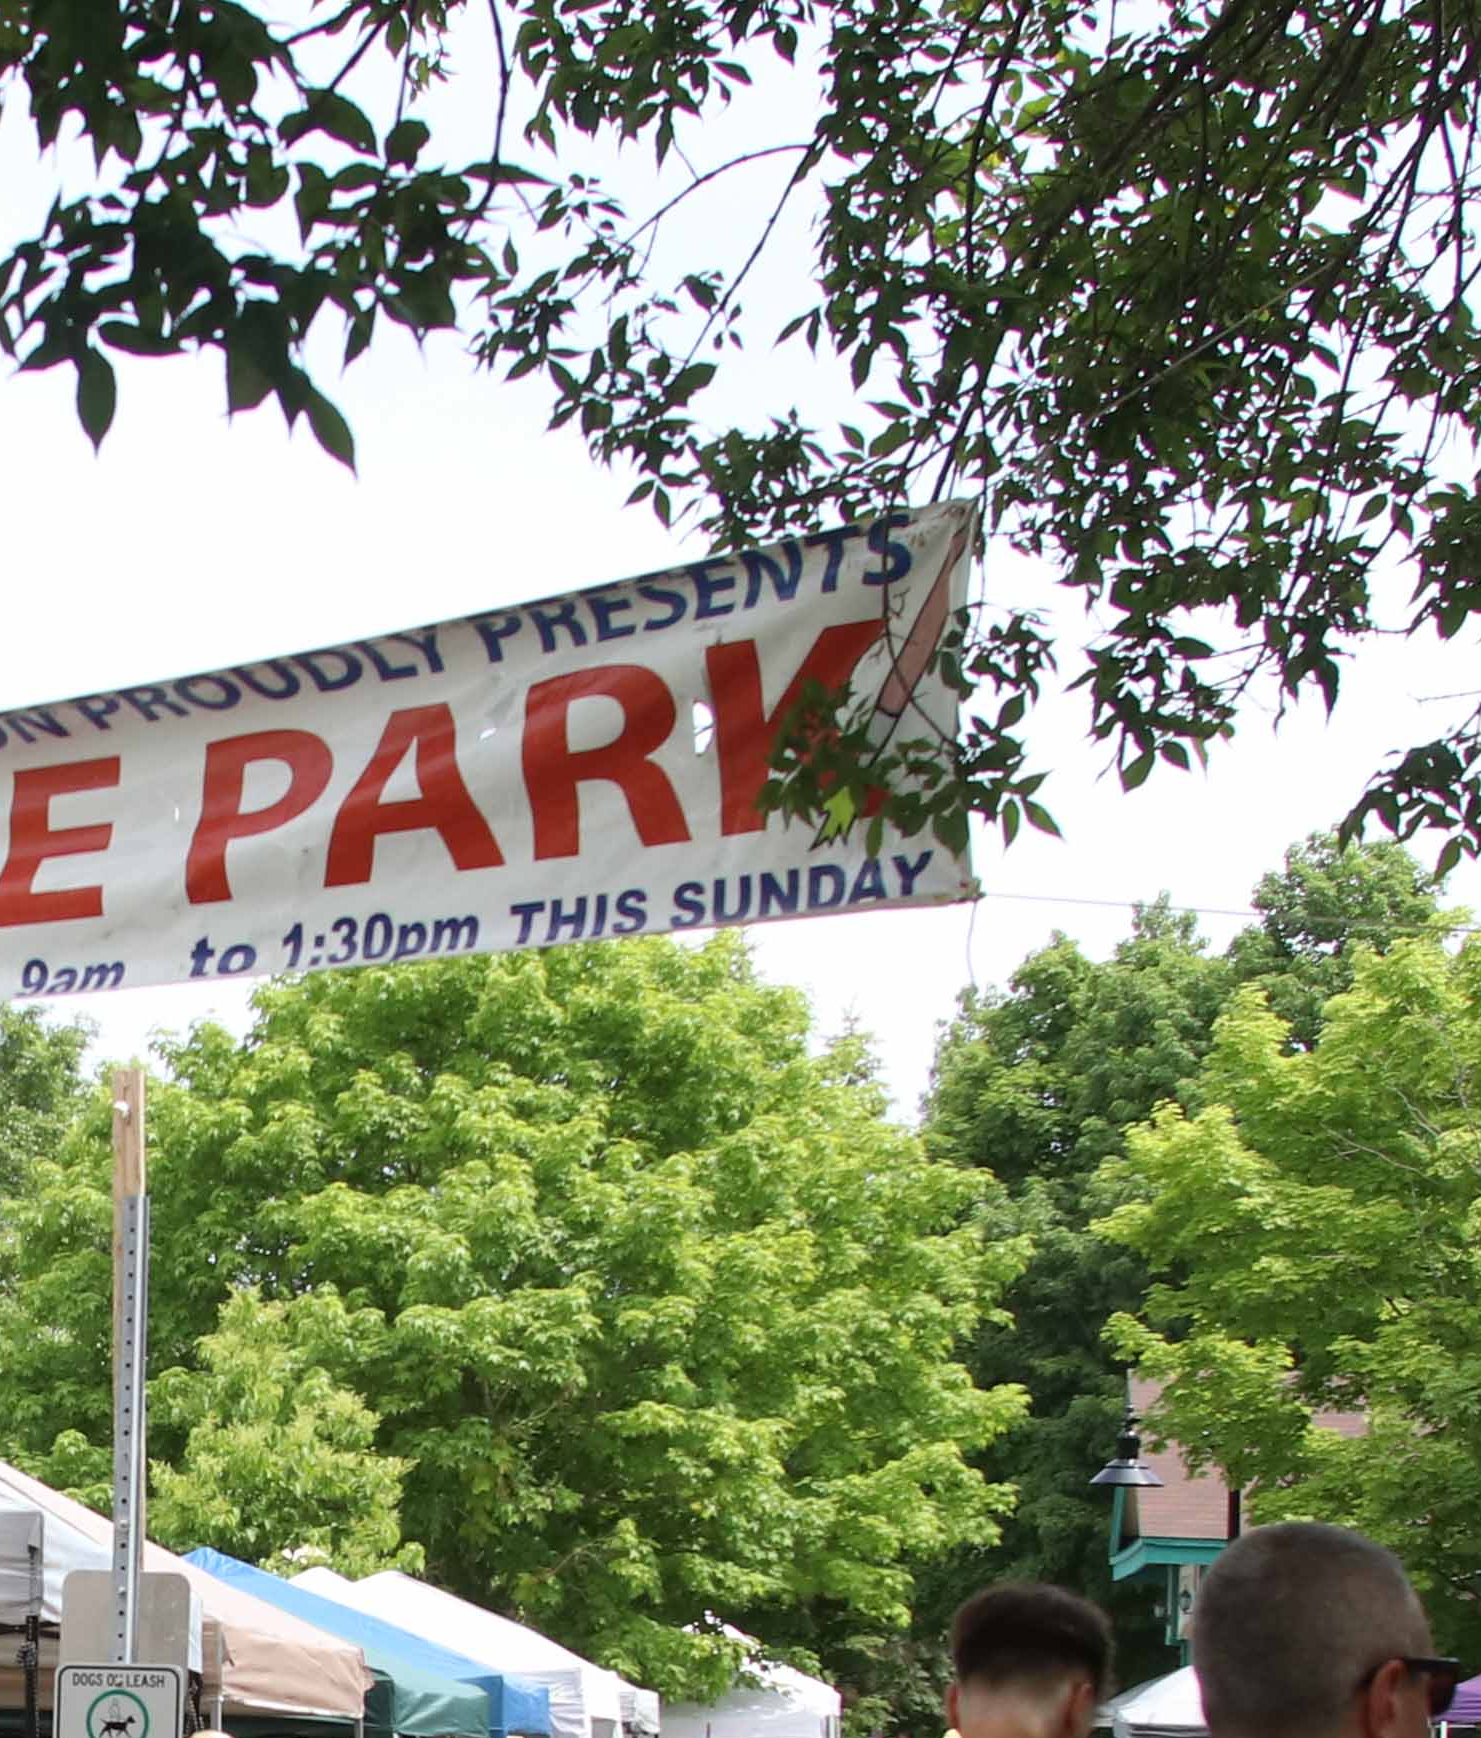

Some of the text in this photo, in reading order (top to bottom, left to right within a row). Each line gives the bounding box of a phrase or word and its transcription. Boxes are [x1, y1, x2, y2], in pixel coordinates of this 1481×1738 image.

[68, 623, 447, 730] PROUDLY
[473, 514, 913, 664] PRESENTS
[185, 618, 888, 906] PARK
[15, 957, 125, 998] 9am
[189, 936, 257, 979] to
[281, 912, 479, 970] 1:30pm
[511, 887, 647, 946] THIS
[670, 849, 934, 930] SUNDAY
[72, 1672, 165, 1689] DOGS O LEASH
